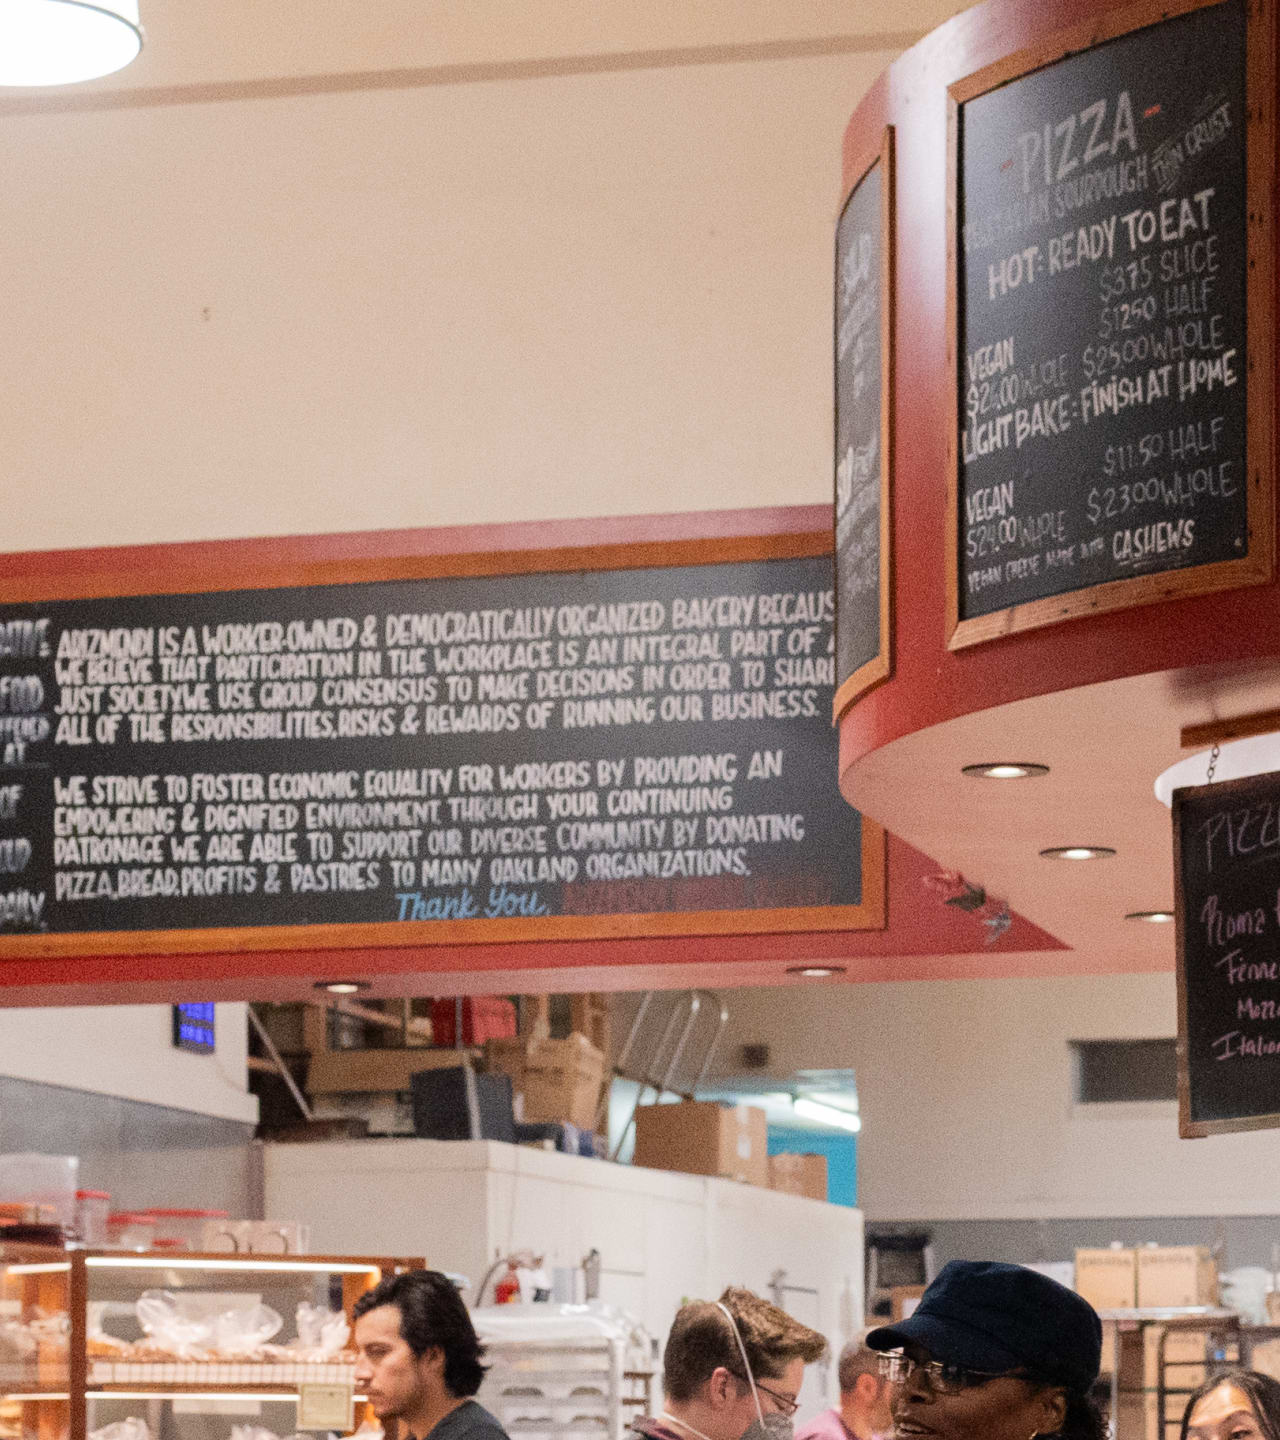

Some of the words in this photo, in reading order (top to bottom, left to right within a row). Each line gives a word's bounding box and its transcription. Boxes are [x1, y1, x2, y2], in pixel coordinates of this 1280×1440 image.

[1018, 90, 1138, 194] PIZZA
[1048, 215, 1117, 276] READY
[1121, 210, 1156, 251] TO
[1160, 188, 1216, 241] EAT
[1160, 236, 1220, 282] SLICE
[967, 336, 1015, 382] VEGAN
[963, 412, 1014, 464] LIGHT
[1147, 365, 1173, 406] AT
[1178, 348, 1238, 401] HOME
[1170, 416, 1224, 460] HALF
[966, 480, 1015, 525] VEGAN
[1112, 519, 1196, 562] CASHEWS
[159, 626, 180, 656] IS
[182, 625, 199, 655] A
[360, 614, 379, 647] &
[557, 600, 666, 637] ORGANIZED
[673, 596, 755, 630] BAKERY
[54, 775, 87, 805] WE
[92, 774, 159, 804] STRIVE
[164, 774, 190, 800] TO
[191, 772, 266, 801] FOSTER
[268, 771, 360, 800] ECONOMIC
[364, 768, 453, 799] EQUALITY
[458, 764, 494, 793] FOR
[499, 760, 592, 790] WORKERS
[597, 759, 626, 788] BY
[634, 752, 738, 787] PROVIDING
[747, 749, 784, 780] AN
[54, 805, 177, 838] EMPOWERING
[180, 802, 200, 833] &
[204, 802, 301, 832] DIGNIFIED
[305, 797, 441, 830] ENVIRONMENT
[446, 794, 538, 823] THROUGH
[545, 792, 599, 820] YOUR
[607, 786, 734, 817] CONTINUING
[54, 835, 165, 867] PATRONAGE
[170, 834, 203, 864] WE
[206, 833, 245, 863] ARE
[249, 832, 298, 863] ABLE
[306, 832, 335, 861] TO
[341, 829, 423, 861] SUPPORT
[427, 827, 462, 856] OUR
[470, 825, 548, 855] DIVERSE
[556, 819, 666, 852] COMMUNITY
[672, 819, 699, 849] BY
[706, 814, 805, 844] DONATING
[181, 865, 257, 896] PROFITS
[263, 864, 281, 894] &
[290, 861, 380, 894] PASTRIES
[391, 861, 416, 888] TO
[423, 857, 483, 887] MANY
[489, 855, 579, 884] OAKLAND
[394, 888, 478, 921] Thank
